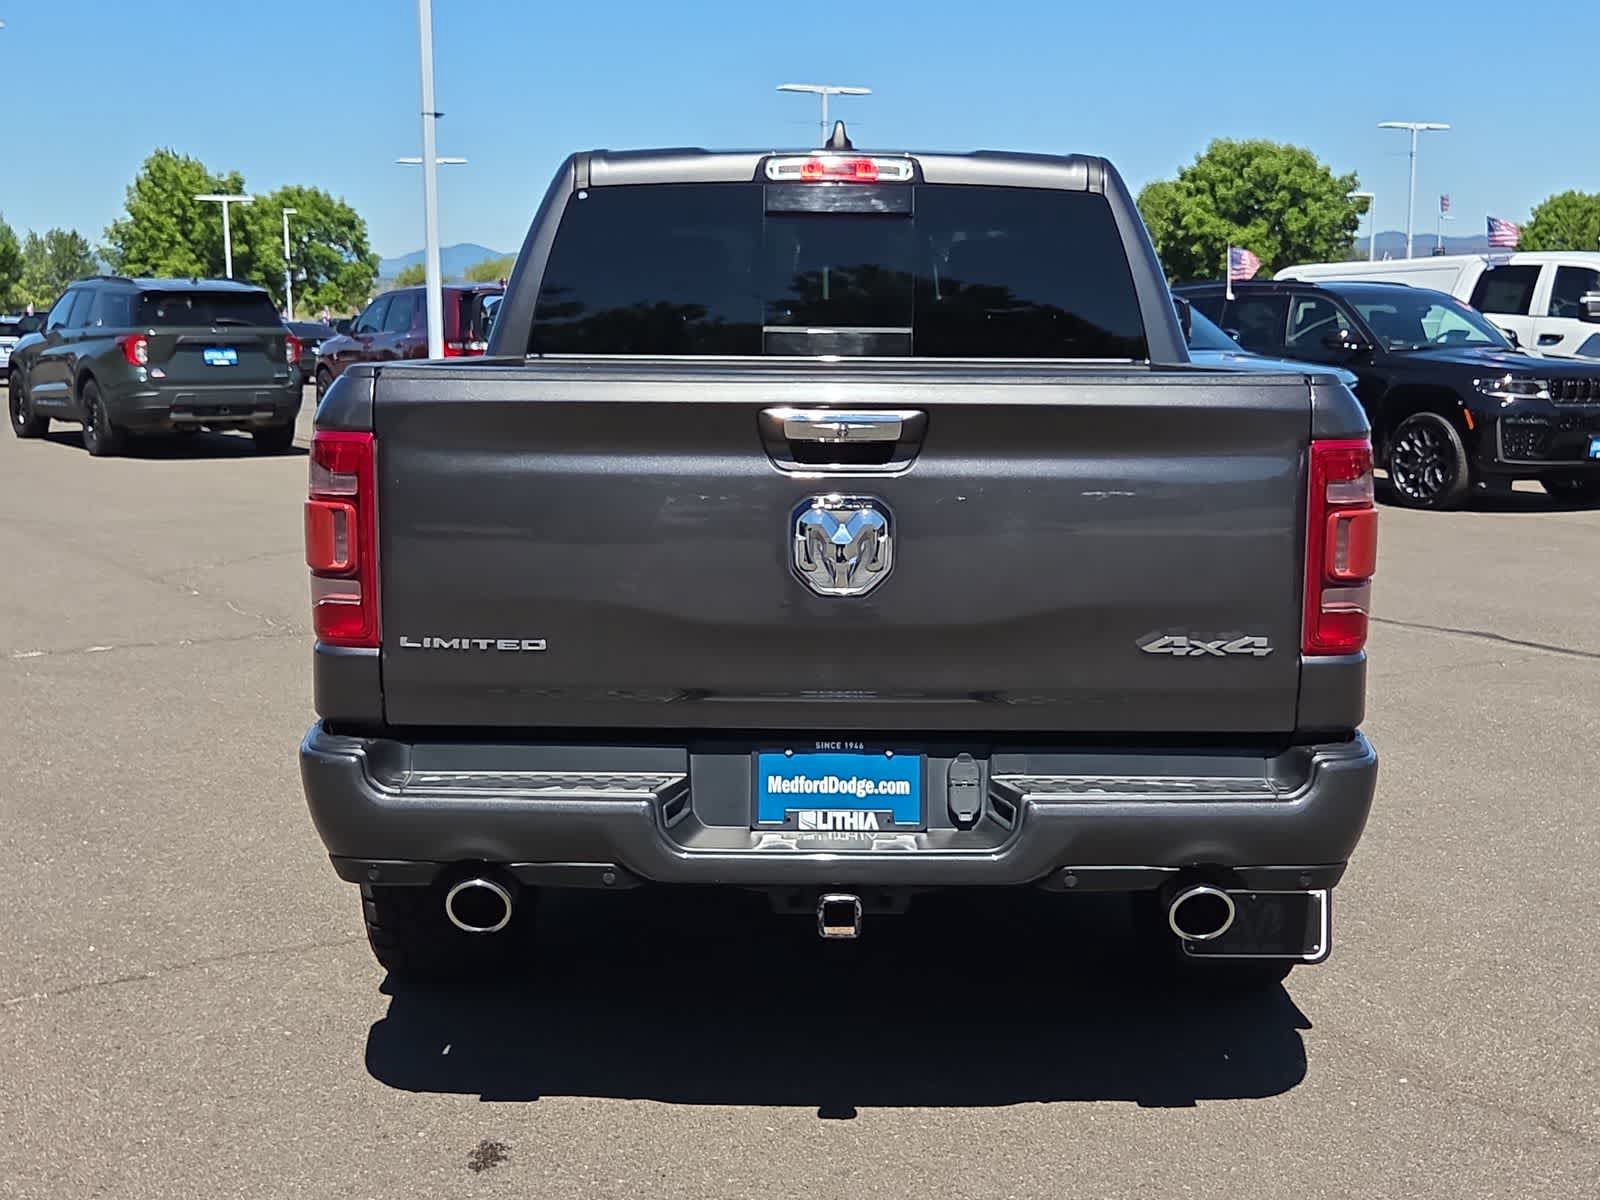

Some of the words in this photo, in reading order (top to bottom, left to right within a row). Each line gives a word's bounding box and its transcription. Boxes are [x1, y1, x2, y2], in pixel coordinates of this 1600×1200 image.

[399, 636, 547, 651] LIMITED
[1139, 635, 1274, 657] 4x4
[815, 741, 842, 750] SINCE
[844, 741, 864, 750] 1946
[767, 775, 910, 798] MedfordDodge.com
[816, 811, 880, 830] LITHIA
